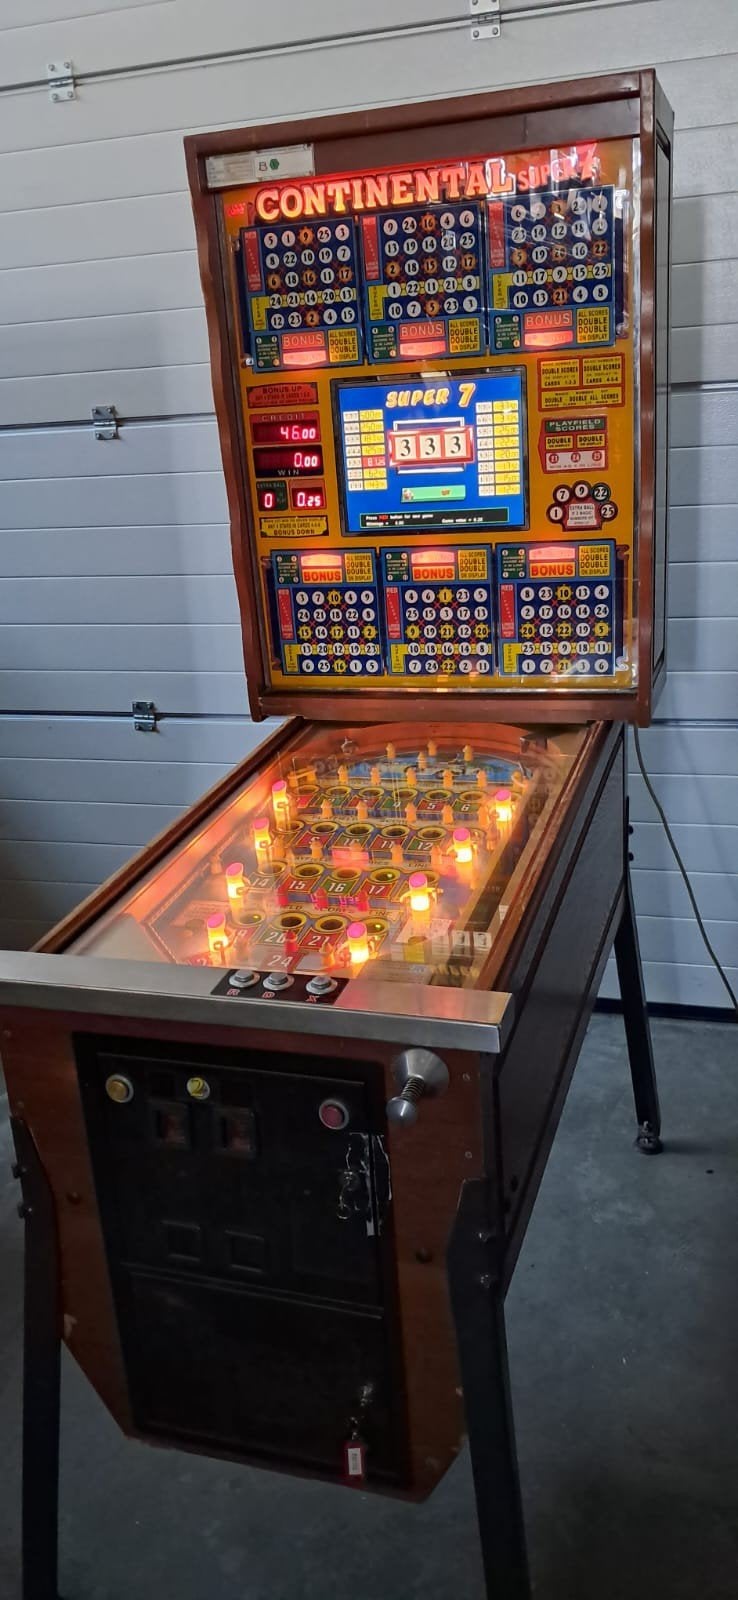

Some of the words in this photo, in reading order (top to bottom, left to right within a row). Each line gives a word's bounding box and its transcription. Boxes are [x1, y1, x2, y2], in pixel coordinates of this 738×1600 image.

[259, 161, 268, 171] B
[256, 161, 515, 221] CONTINENTAL
[403, 220, 415, 231] 24
[318, 229, 330, 240] 25
[534, 227, 544, 239] 14
[554, 225, 565, 236] 12
[387, 242, 397, 254] 13
[406, 241, 416, 252] 19
[425, 239, 435, 250] 14
[462, 234, 474, 246] 25
[284, 254, 296, 265] 22
[303, 252, 313, 262] 10
[321, 250, 331, 261] 19
[535, 249, 545, 261] 19
[575, 245, 586, 257] 16
[595, 243, 608, 254] 22
[407, 262, 417, 273] 18
[445, 259, 455, 269] 12
[287, 274, 297, 285] 18
[516, 273, 525, 284] 11
[535, 270, 545, 282] 17
[575, 267, 586, 278] 15
[594, 265, 607, 277] 25
[407, 283, 419, 294] 22
[445, 280, 455, 290] 21
[270, 296, 282, 307] 24
[306, 293, 316, 303] 14
[323, 291, 335, 302] 20
[342, 289, 352, 300] 13
[516, 294, 527, 305] 10
[536, 292, 546, 303] 13
[391, 305, 401, 316] 10
[446, 300, 458, 311] 23
[290, 314, 301, 325] 23
[343, 309, 353, 320] 15
[526, 314, 571, 327] BONUS
[578, 317, 608, 325] DOUBLE
[401, 324, 444, 337] BONUS
[450, 328, 478, 336] DOUBLE
[578, 325, 608, 334] DOUBLE
[283, 334, 324, 347] BONUS
[330, 338, 356, 346] DOUBLE
[450, 336, 478, 344] DOUBLE
[386, 388, 450, 408] SUPER
[458, 383, 476, 408] 7
[280, 425, 316, 440] 46.00
[400, 439, 411, 457] 3
[424, 437, 436, 455] 3
[450, 435, 461, 454] 3
[294, 452, 318, 468] 0.00
[297, 492, 321, 507] 0.25
[560, 490, 566, 500] 7
[595, 488, 607, 497] 22
[264, 493, 272, 508] 0
[602, 507, 614, 516] 25
[303, 571, 341, 581] BONUS
[414, 568, 454, 579] BONUS
[531, 565, 573, 576] BONUS
[331, 593, 339, 603] 10
[457, 591, 469, 600] 23
[540, 589, 552, 599] 23
[578, 587, 588, 598] 13
[299, 611, 309, 620] 24
[315, 611, 324, 620] 21
[332, 611, 341, 619] 18
[347, 610, 357, 619] 22
[407, 609, 418, 619] 25
[459, 608, 469, 618] 17
[477, 608, 486, 618] 13
[541, 607, 551, 617] 17
[560, 607, 570, 616] 16
[578, 606, 588, 616] 14
[596, 606, 608, 616] 24
[317, 628, 326, 637] 14
[426, 627, 435, 636] 19
[460, 627, 470, 636] 12
[477, 627, 487, 636] 20
[522, 626, 533, 636] 20
[542, 626, 552, 635] 12
[558, 626, 570, 635] 22
[579, 625, 589, 634] 19
[318, 645, 329, 654] 20
[334, 645, 343, 654] 12
[350, 645, 360, 654] 19
[366, 645, 377, 654] 23
[410, 644, 419, 654] 10
[460, 645, 470, 653] 14
[523, 644, 534, 653] 25
[319, 662, 329, 670] 25
[427, 662, 437, 671] 24
[443, 662, 454, 671] 22
[427, 801, 436, 810] 5
[461, 803, 470, 812] 6
[417, 842, 434, 851] 12
[289, 880, 306, 890] 15
[328, 882, 346, 892] 16
[369, 885, 385, 895] 17
[308, 935, 330, 946] 21
[268, 954, 293, 968] 24
[191, 1079, 202, 1094] 2
